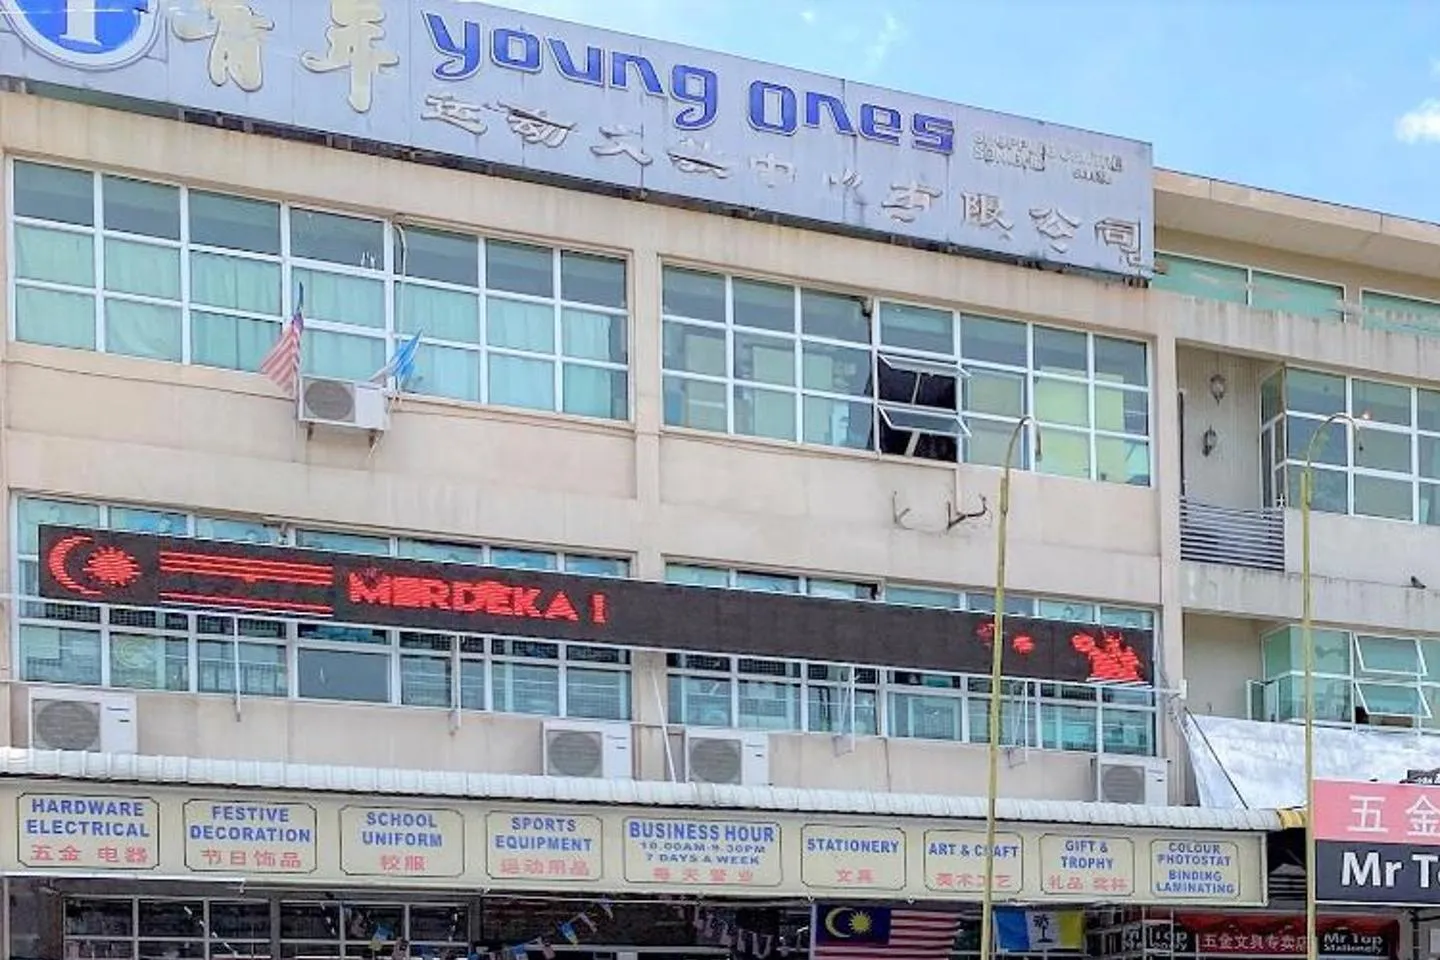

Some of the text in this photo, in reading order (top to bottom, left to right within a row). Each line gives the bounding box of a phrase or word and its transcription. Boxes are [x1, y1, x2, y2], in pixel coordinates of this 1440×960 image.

[346, 571, 579, 622] MERDEKA
[30, 797, 145, 817] HARDWARE
[211, 805, 290, 823] FESTIVE
[26, 819, 150, 837] ELECTRICAL
[366, 811, 438, 829] SCHOOL
[511, 816, 577, 833] SPORTS
[189, 825, 312, 843] DECORATION
[361, 830, 443, 848] UNIFORM
[628, 820, 775, 843] BUSINESS HOUR
[494, 834, 593, 852] EQUIPMENT
[806, 837, 900, 855] STATIONERY
[928, 842, 1019, 859] ART & CAFT
[1064, 839, 1097, 853] GIFT
[1168, 842, 1221, 855] COLOUR
[659, 853, 698, 863] DAYS
[716, 855, 760, 866] WEEK
[1060, 855, 1114, 870] TROPHY
[1157, 854, 1231, 868] PHOTOSTAT
[1341, 850, 1403, 887] Mr
[1168, 870, 1222, 883] BINDING
[1156, 882, 1235, 895] LAMINATING
[1323, 931, 1384, 947] Mr Top
